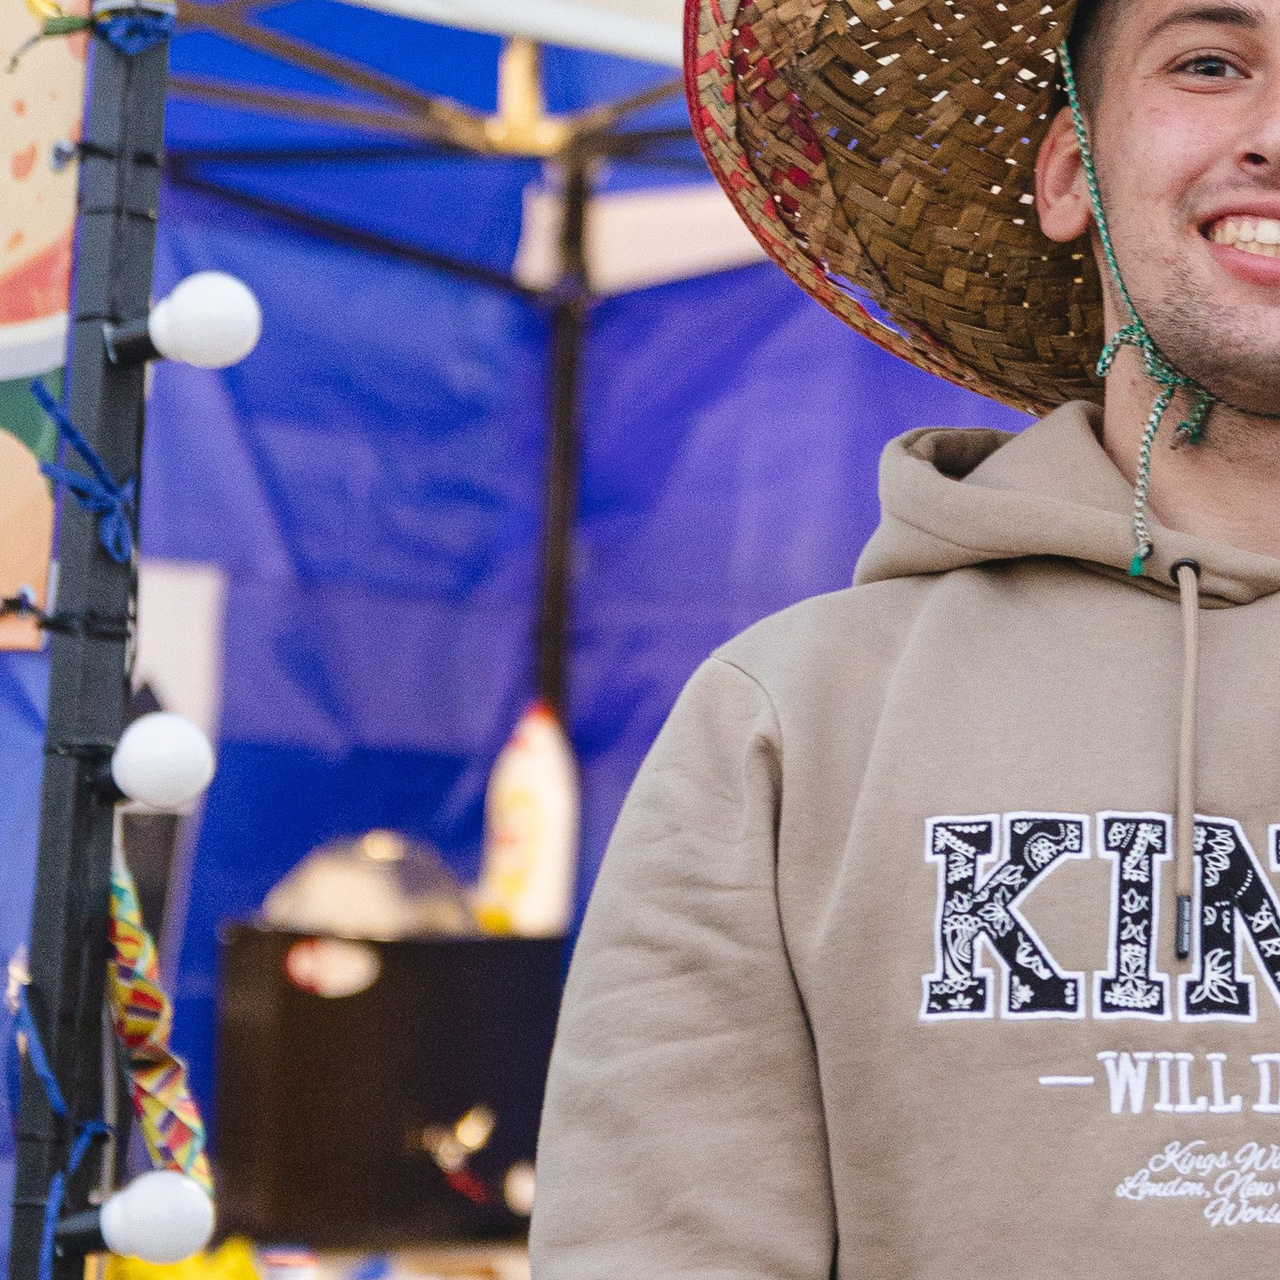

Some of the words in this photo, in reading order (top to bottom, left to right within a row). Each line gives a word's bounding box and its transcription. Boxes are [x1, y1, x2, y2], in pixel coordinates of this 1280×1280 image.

[1096, 1050, 1242, 1115] WILL
[1149, 1140, 1231, 1176] Kings
[1115, 1169, 1212, 1201] London,
[1213, 1169, 1276, 1200] New
